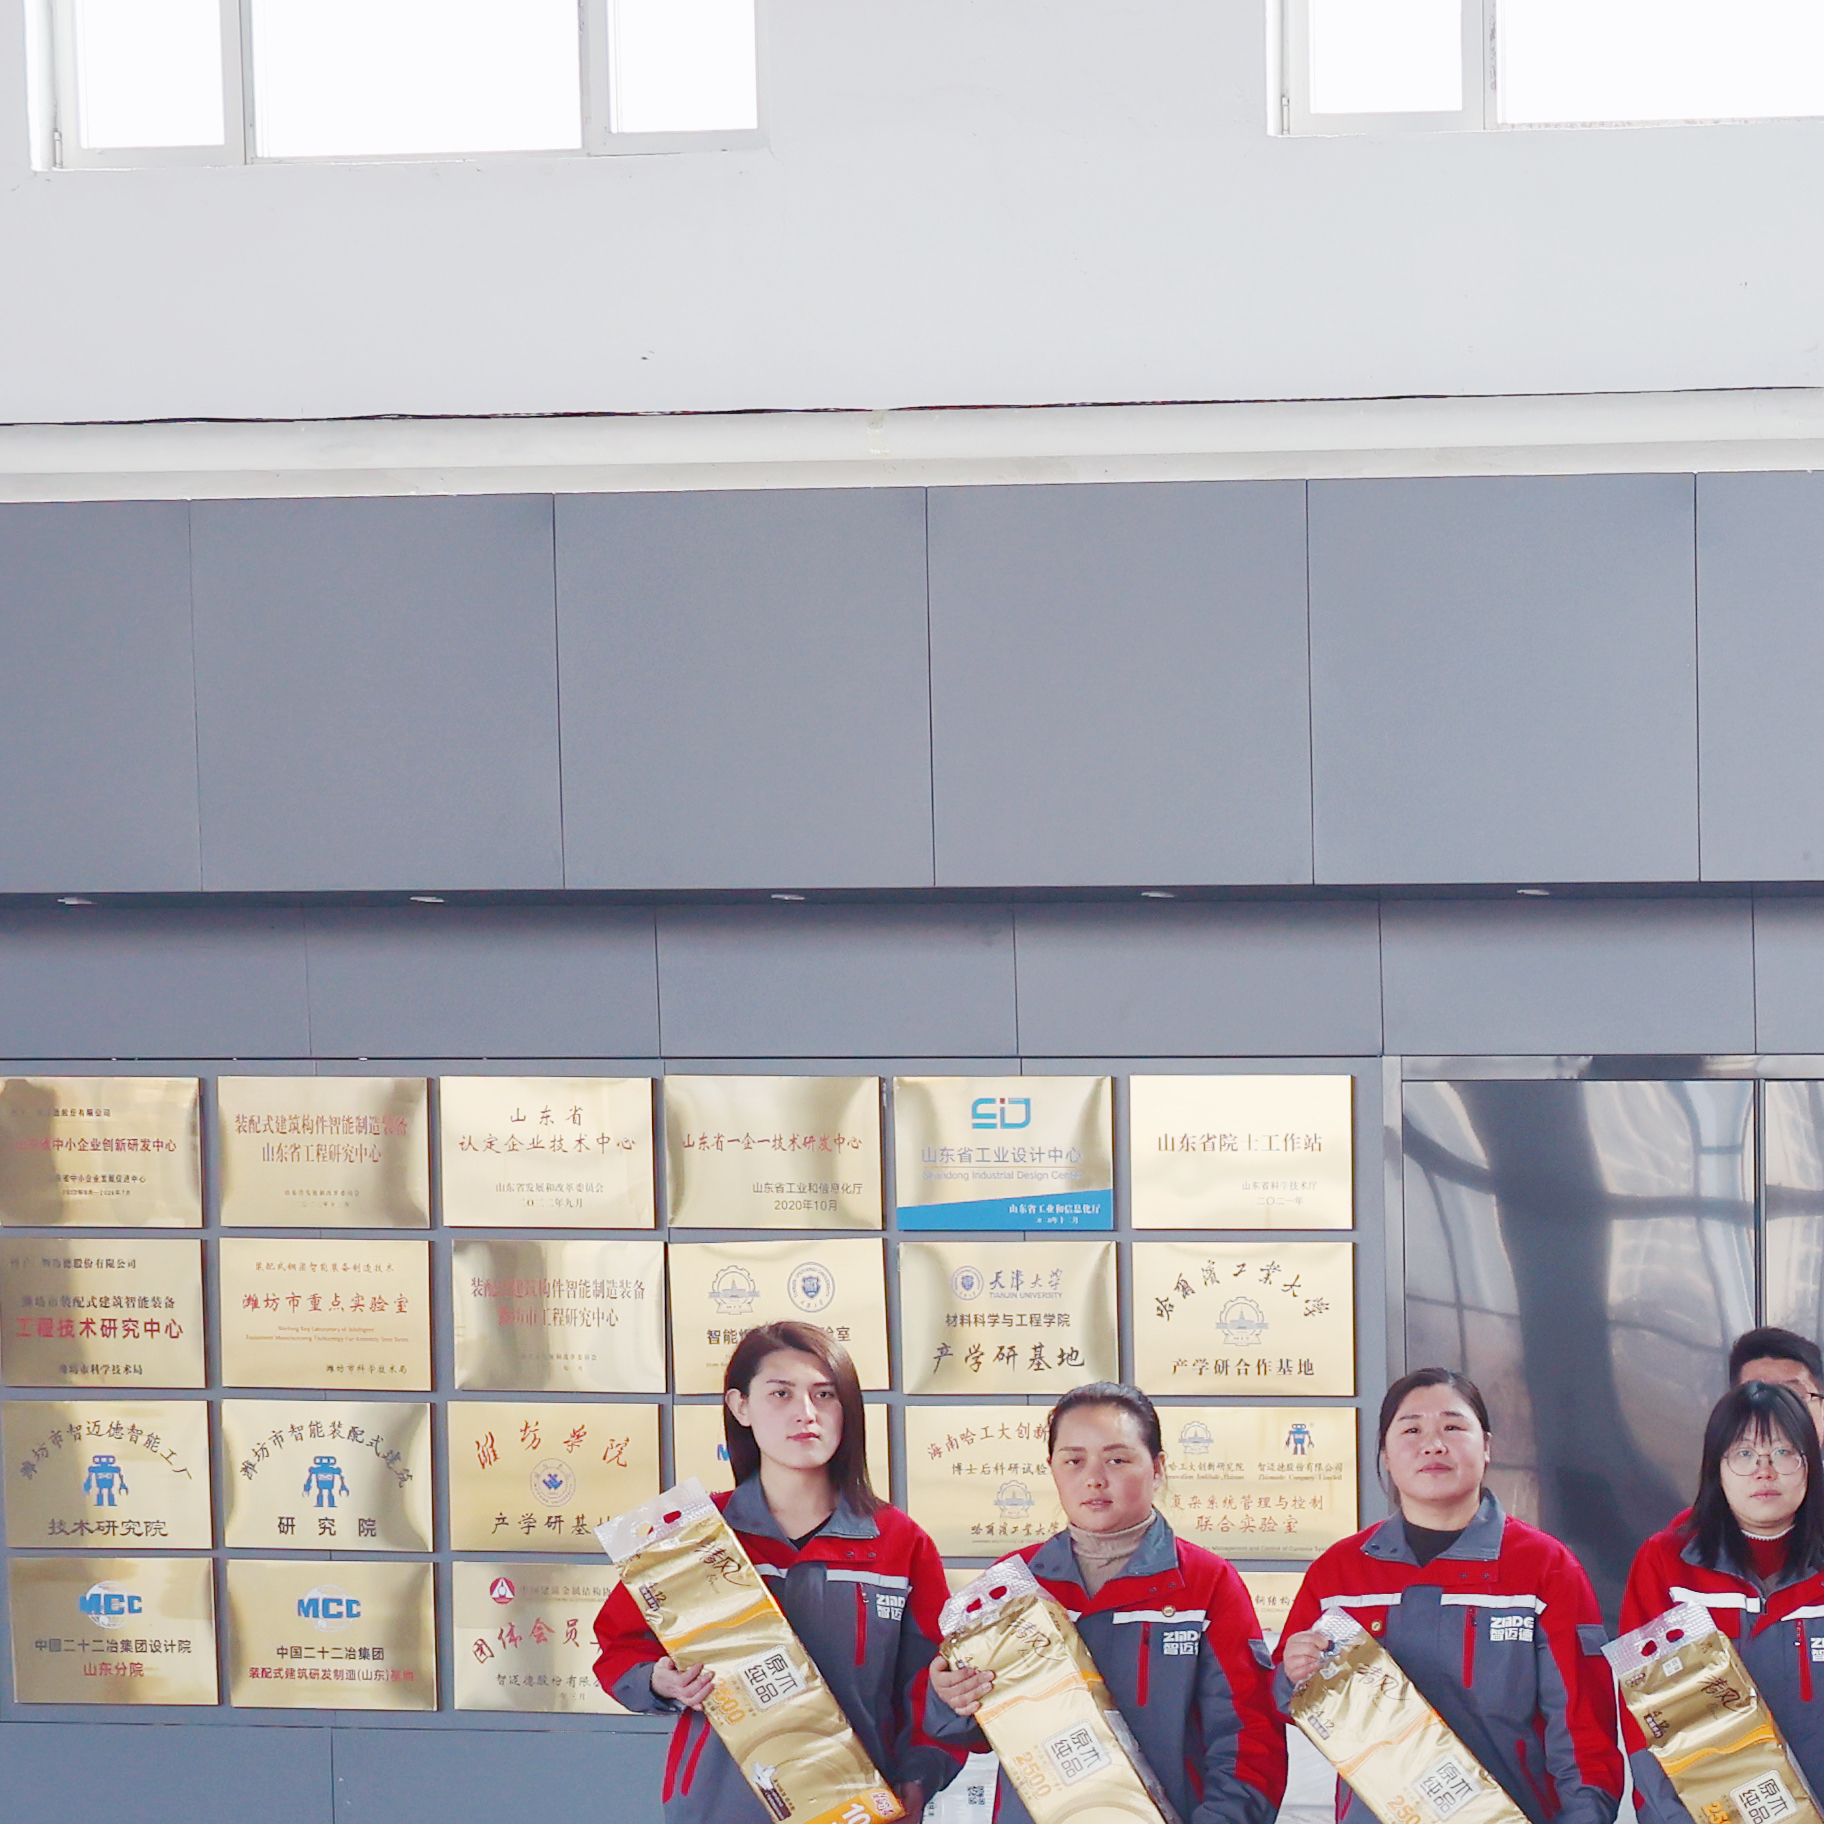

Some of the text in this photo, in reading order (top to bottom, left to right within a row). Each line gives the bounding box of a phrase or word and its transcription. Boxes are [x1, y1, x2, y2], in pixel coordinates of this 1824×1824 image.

[235, 1113, 408, 1136] 装配式建筑构件智能制造装备
[510, 1105, 584, 1126] 山东省
[459, 1132, 637, 1154] 认定企业技术中心
[682, 1132, 863, 1154] 山东省一企一技术研发中心
[1157, 1133, 1323, 1152] 山东省院士工作站
[262, 1143, 382, 1164] 山东省工程研究中心
[922, 1146, 1083, 1164] 山东省工业设计中心
[972, 1170, 1014, 1179] Industrial
[1017, 1170, 1049, 1181] Design
[496, 1182, 605, 1194] 山东省发展和改革委员会
[752, 1182, 864, 1194] 山东省工业和信息化厅
[774, 1199, 838, 1211] 2020年10月
[242, 1291, 410, 1314] 潍坊市重点实验室
[16, 1317, 184, 1340] 工程技术研究中心
[945, 1313, 1071, 1327] 材料科学与工程学院
[933, 1342, 1085, 1375] 产学研基地
[1172, 1358, 1315, 1376] 产学研合作基地
[48, 1519, 169, 1537] 技术研究院
[278, 1516, 377, 1537] 研究院
[1195, 1514, 1299, 1534] 联合实验室
[79, 1593, 144, 1616] MCC
[297, 1597, 362, 1619] MCC
[1489, 1628, 1534, 1642] 智迈德
[35, 1638, 192, 1654] 中国二十二冶集团设计院
[276, 1645, 385, 1661] 中国二十二冶集团
[83, 1662, 145, 1678] 山东分院
[764, 1653, 798, 1693] 原木
[744, 1664, 780, 1703] 纯品
[1070, 1727, 1101, 1769] 原木
[1051, 1738, 1084, 1780] 纯品
[1437, 1761, 1477, 1800] 原木
[1420, 1775, 1457, 1813] 纯品
[1758, 1779, 1789, 1818] 原木
